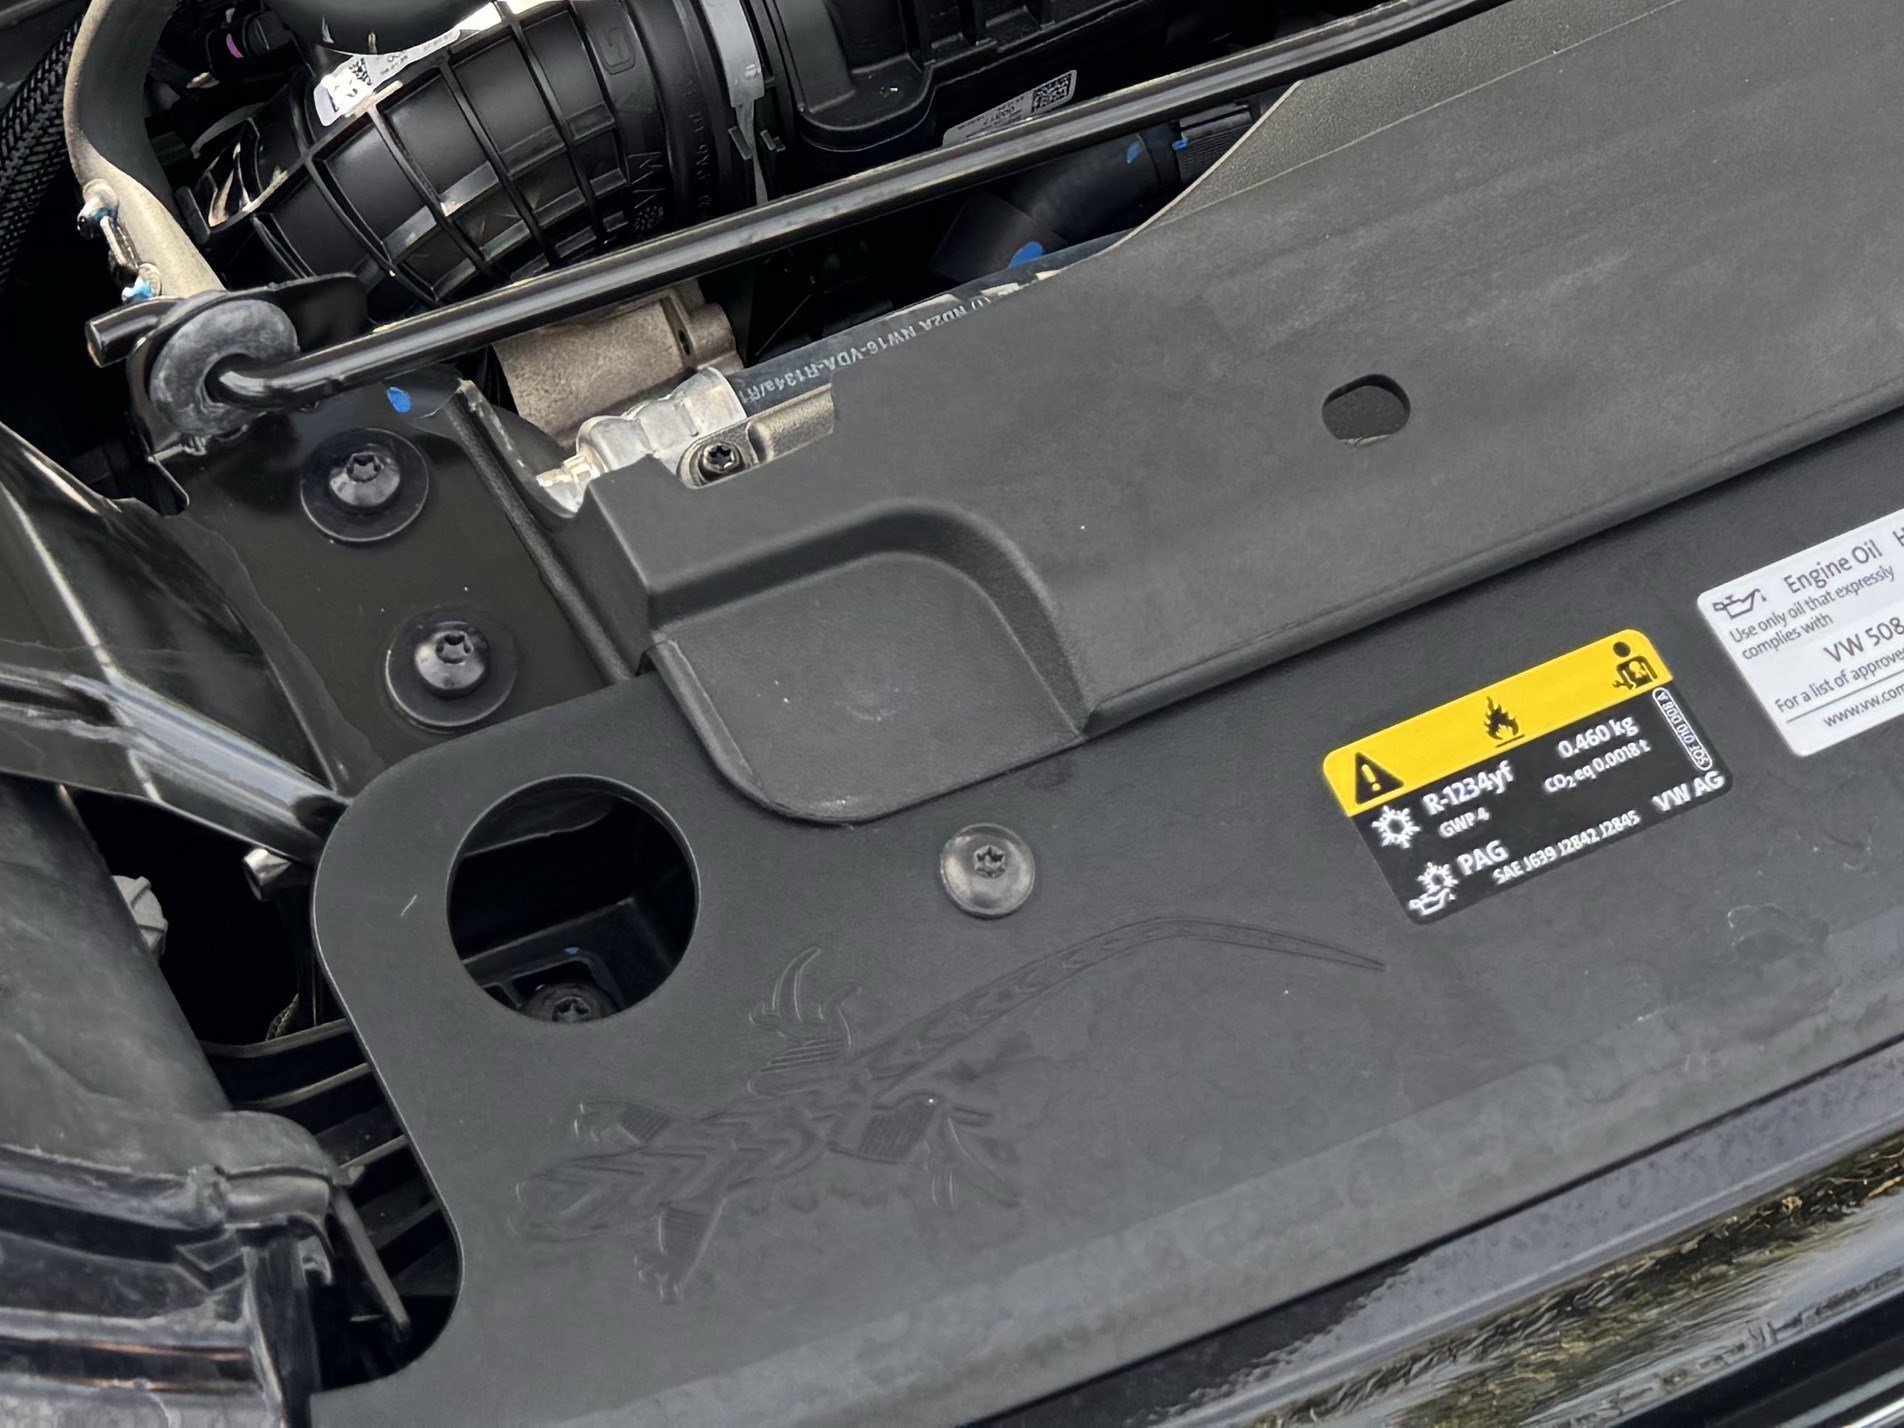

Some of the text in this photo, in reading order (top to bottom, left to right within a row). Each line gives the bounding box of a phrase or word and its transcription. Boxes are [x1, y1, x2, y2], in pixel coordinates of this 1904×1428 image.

[1781, 539, 1883, 598] Engine Oil
[1728, 563, 1898, 644] Use only oil that expressly
[1739, 611, 1834, 662] complies with
[1823, 634, 1867, 664] VW
[1656, 691, 1669, 703] A
[1661, 700, 1682, 725] 008
[1775, 694, 1801, 713] For
[1799, 691, 1812, 702] a
[1808, 678, 1834, 698] list
[1830, 670, 1852, 688] of
[1555, 710, 1640, 759] 0.460 kg
[1675, 722, 1695, 745] 010
[1591, 741, 1642, 773] 0.0018
[1419, 758, 1521, 822] R-1234yf
[1651, 768, 1727, 813] VW AG
[1455, 838, 1510, 877] PAG
[1492, 808, 1641, 886] SAE J639 J2842 J2845
